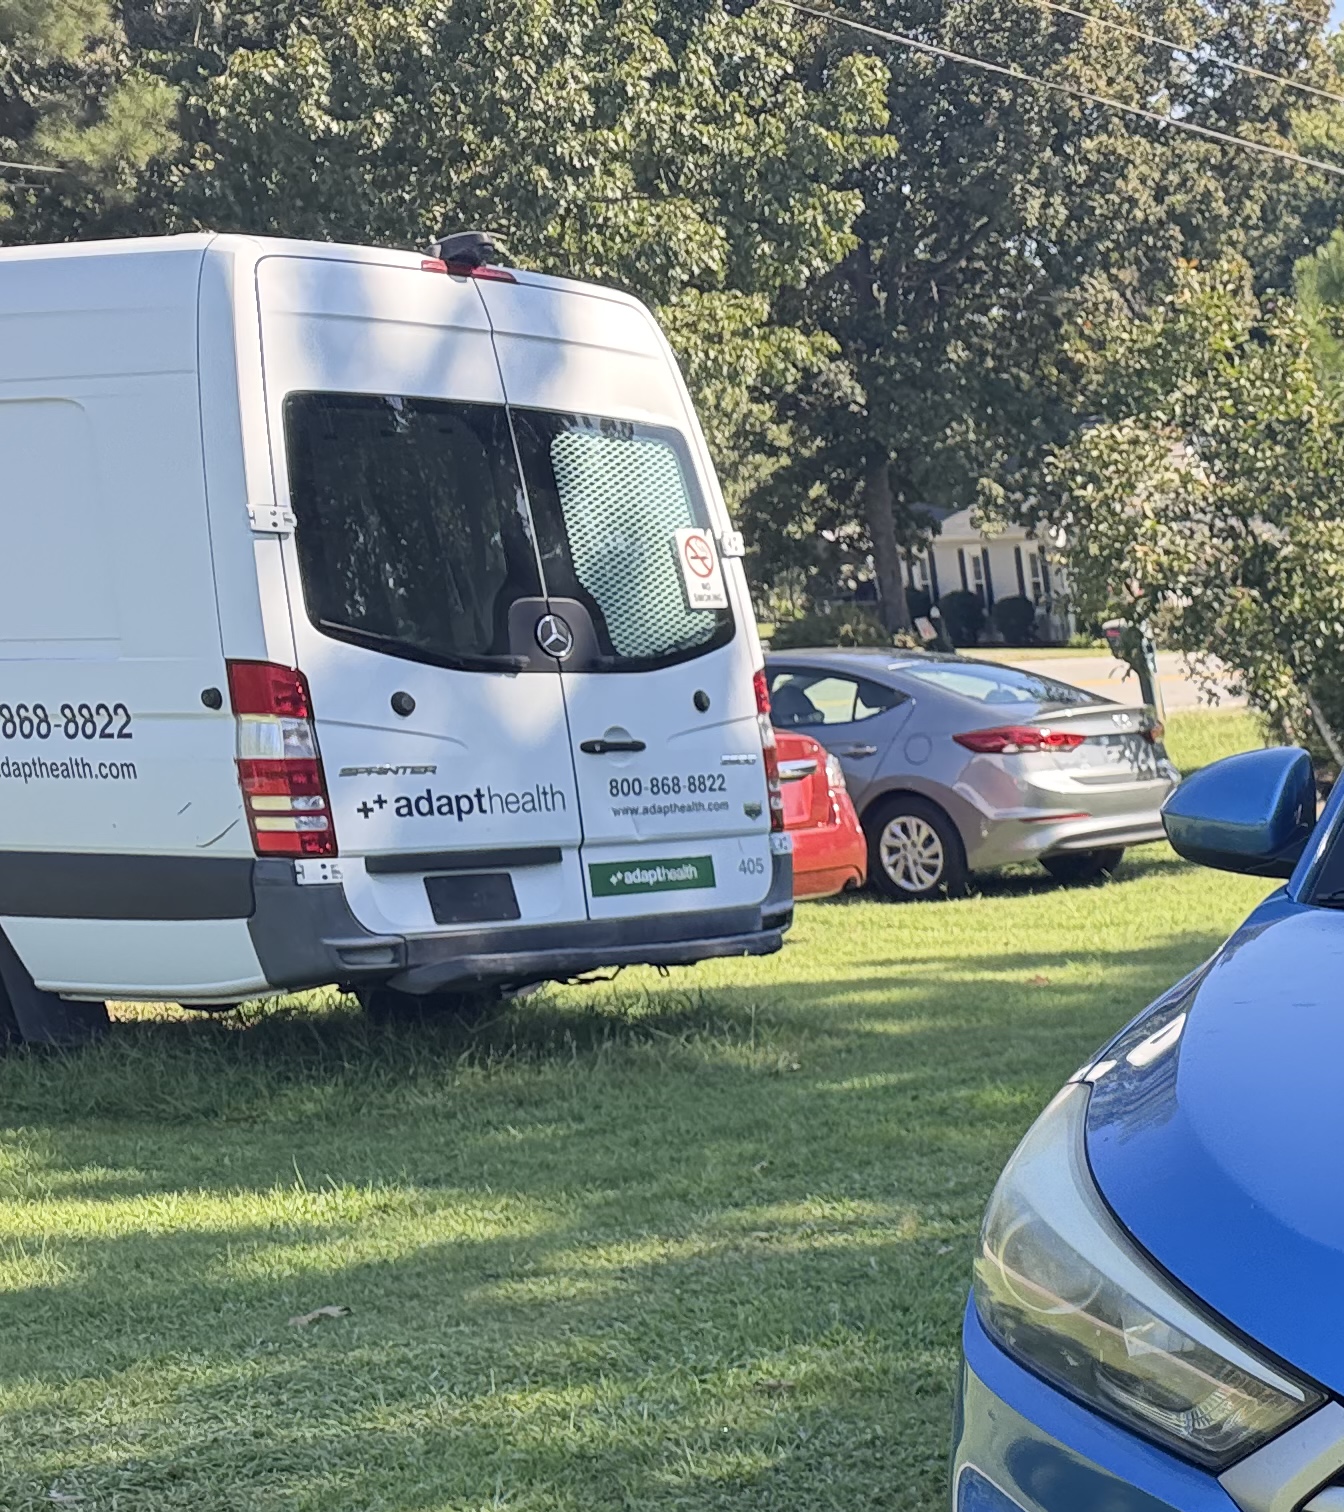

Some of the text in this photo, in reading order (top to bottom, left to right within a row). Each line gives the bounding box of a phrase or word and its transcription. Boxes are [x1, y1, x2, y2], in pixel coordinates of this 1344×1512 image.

[0, 703, 133, 740] 868-8822
[0, 756, 138, 784] dapthealth.com
[339, 765, 437, 777] SPRINTER
[609, 773, 727, 797] 800-868-8822
[394, 783, 567, 822] adapthealth
[612, 800, 729, 817] www.adapthealth.com
[624, 863, 698, 886] adapthealth
[738, 858, 765, 875] 405
